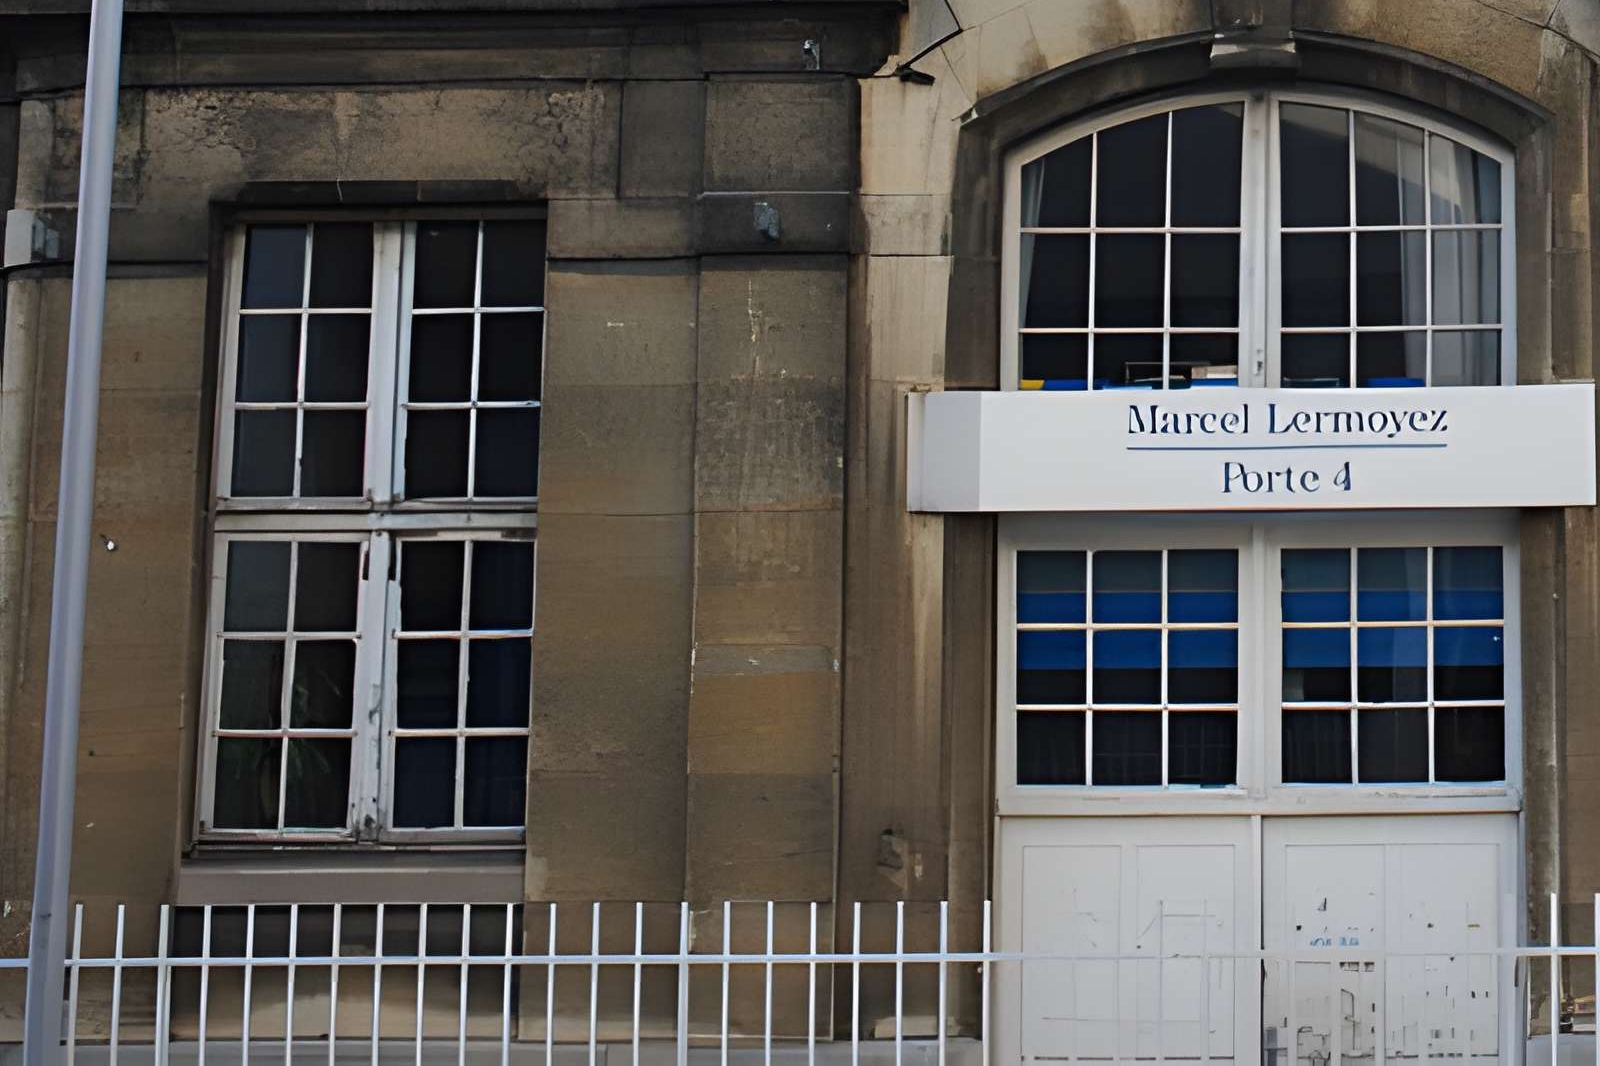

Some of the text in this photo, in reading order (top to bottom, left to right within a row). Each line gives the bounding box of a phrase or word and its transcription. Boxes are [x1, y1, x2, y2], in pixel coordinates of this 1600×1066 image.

[1128, 403, 1449, 439] Marcel Lermoyez
[1222, 461, 1322, 494] Porte
